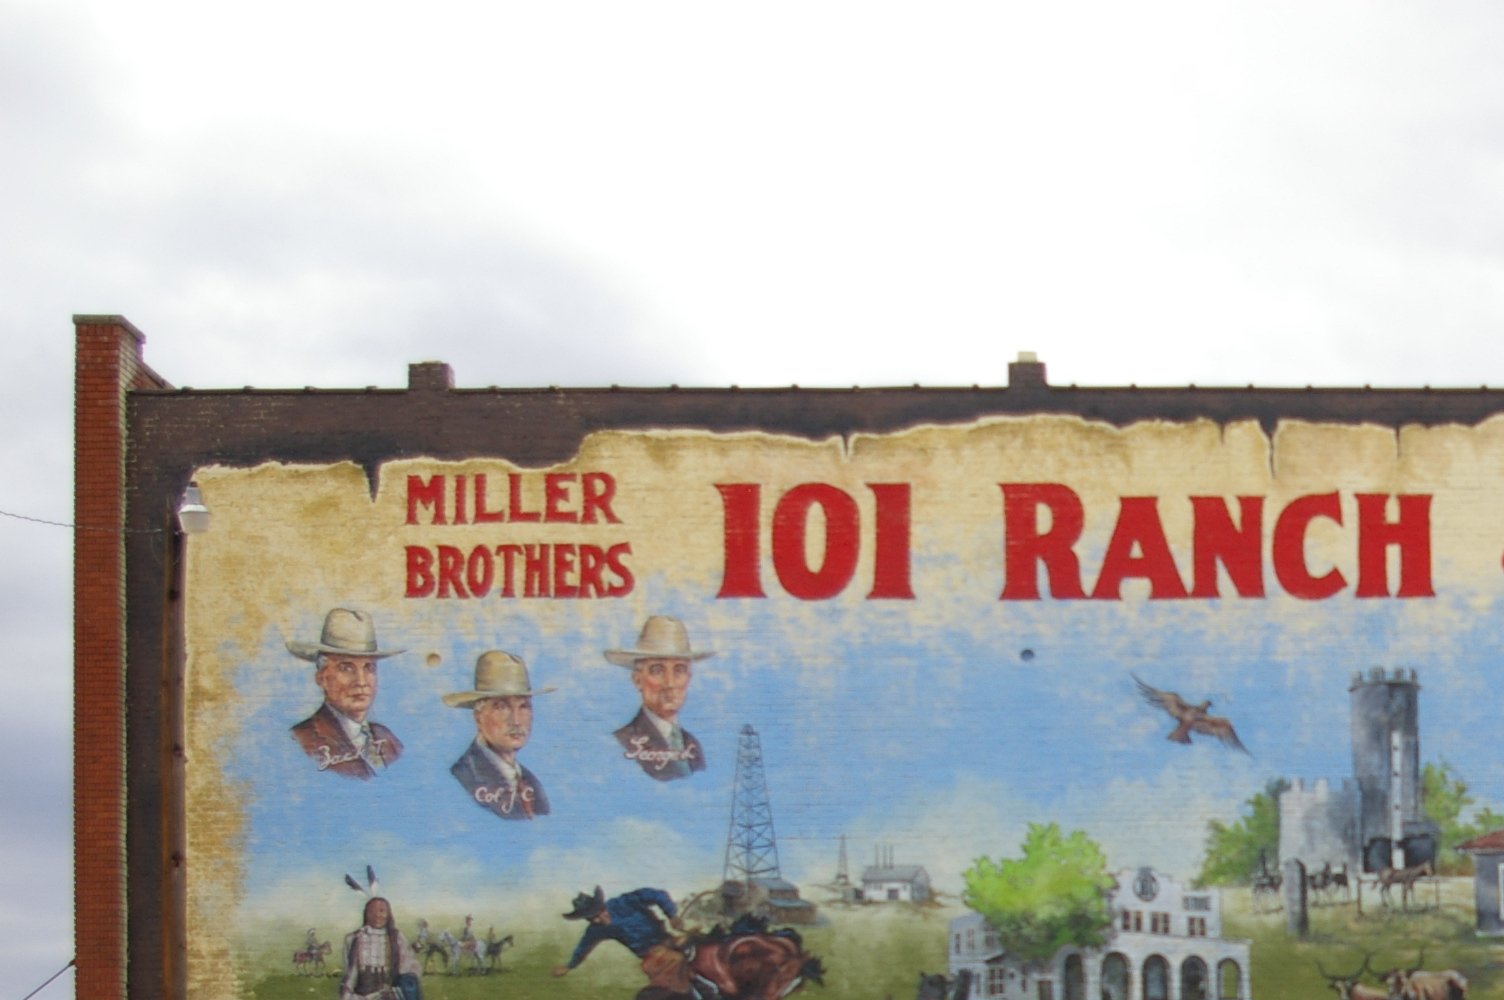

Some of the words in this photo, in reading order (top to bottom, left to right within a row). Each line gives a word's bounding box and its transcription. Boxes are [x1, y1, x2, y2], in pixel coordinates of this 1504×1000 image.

[405, 472, 623, 525] MILLER
[999, 482, 1437, 601] RANCH
[404, 543, 635, 599] BROTHERS
[521, 786, 534, 802] C
